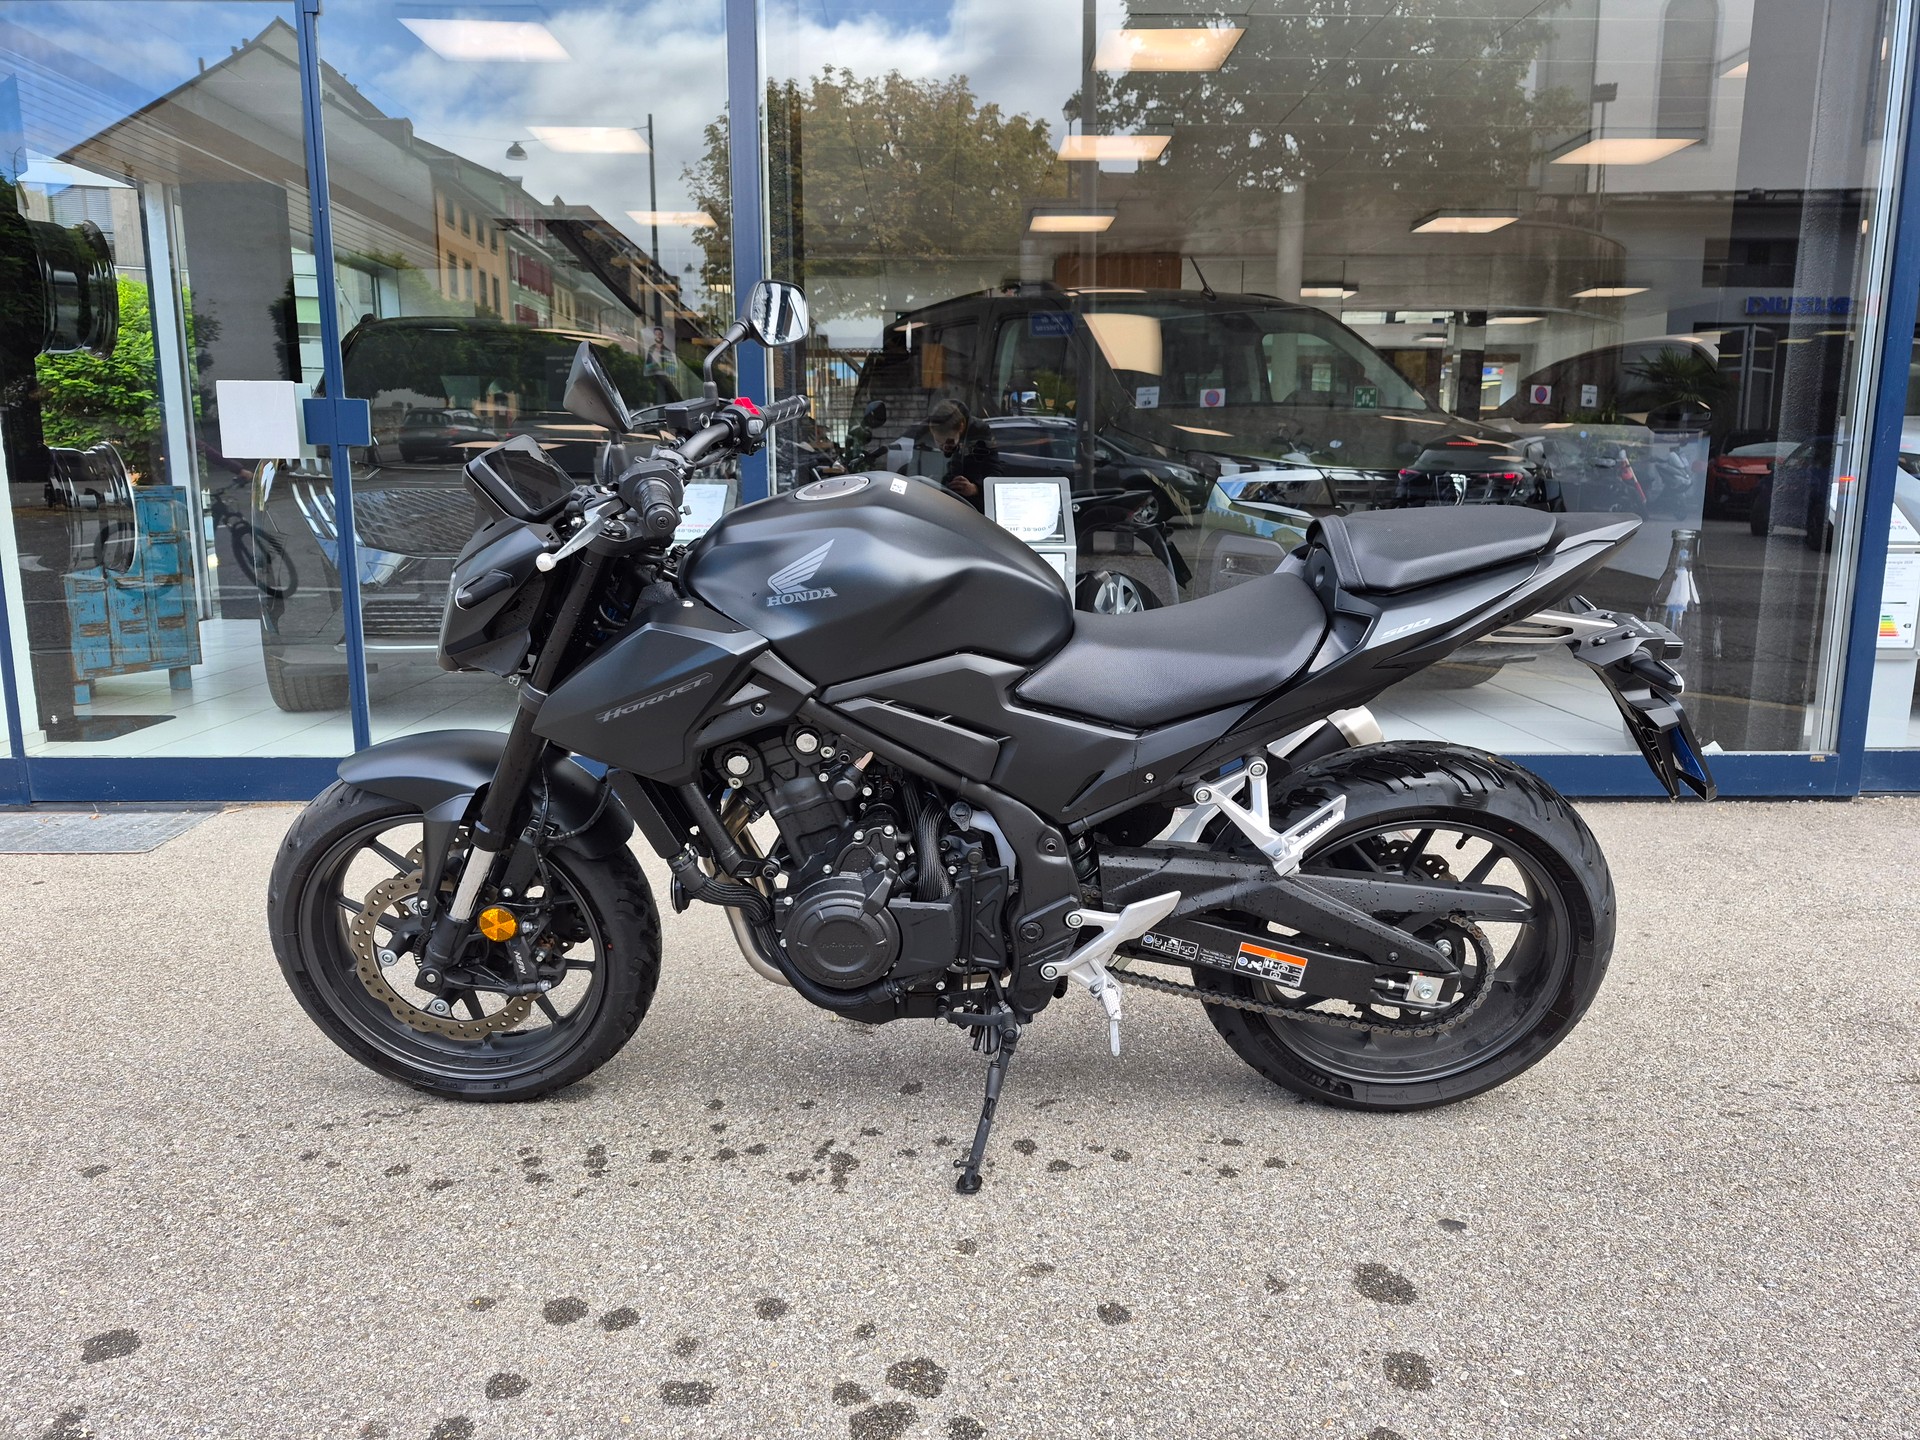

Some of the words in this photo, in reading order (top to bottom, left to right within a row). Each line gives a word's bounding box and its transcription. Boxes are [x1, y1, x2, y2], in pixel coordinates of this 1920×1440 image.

[767, 587, 838, 607] HONDA
[1380, 617, 1432, 640] 500
[596, 676, 710, 723] HORNET
